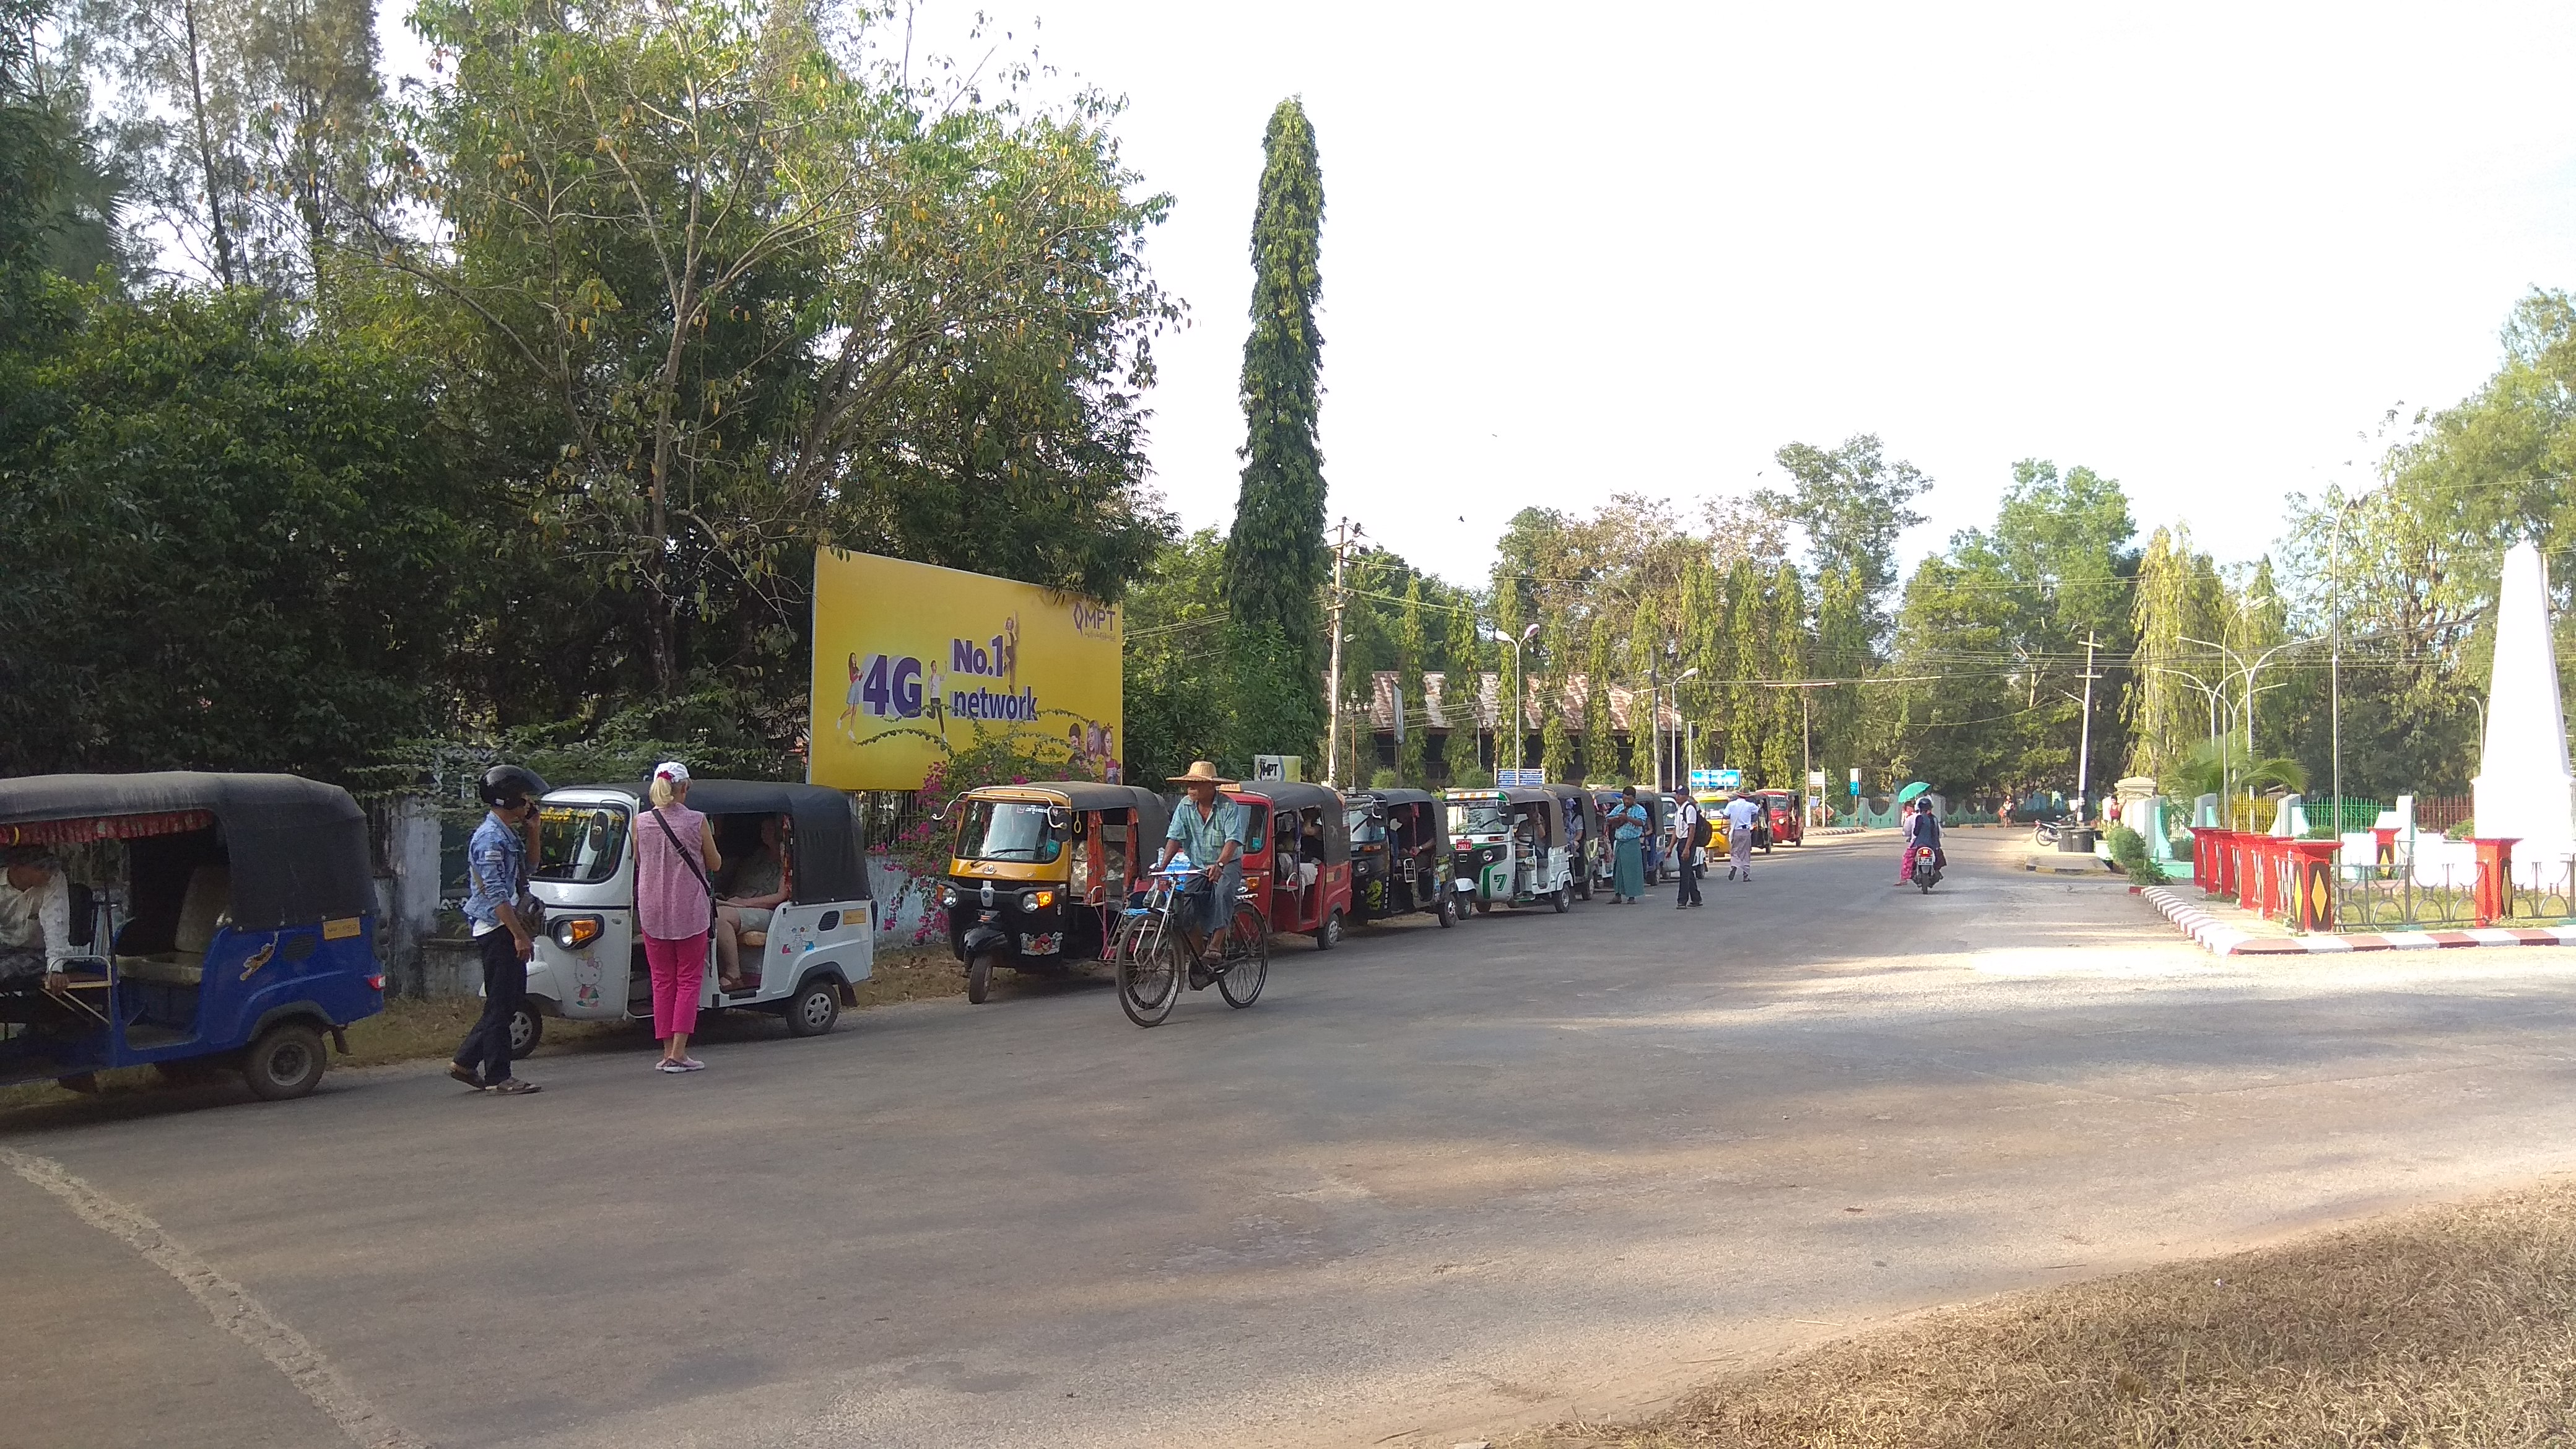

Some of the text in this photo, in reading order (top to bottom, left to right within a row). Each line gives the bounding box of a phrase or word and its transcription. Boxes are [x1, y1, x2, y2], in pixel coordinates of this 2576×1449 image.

[954, 635, 1003, 677] No.1
[863, 654, 922, 718] 4G
[954, 686, 1038, 721] network
[1494, 874, 1508, 891] 7
